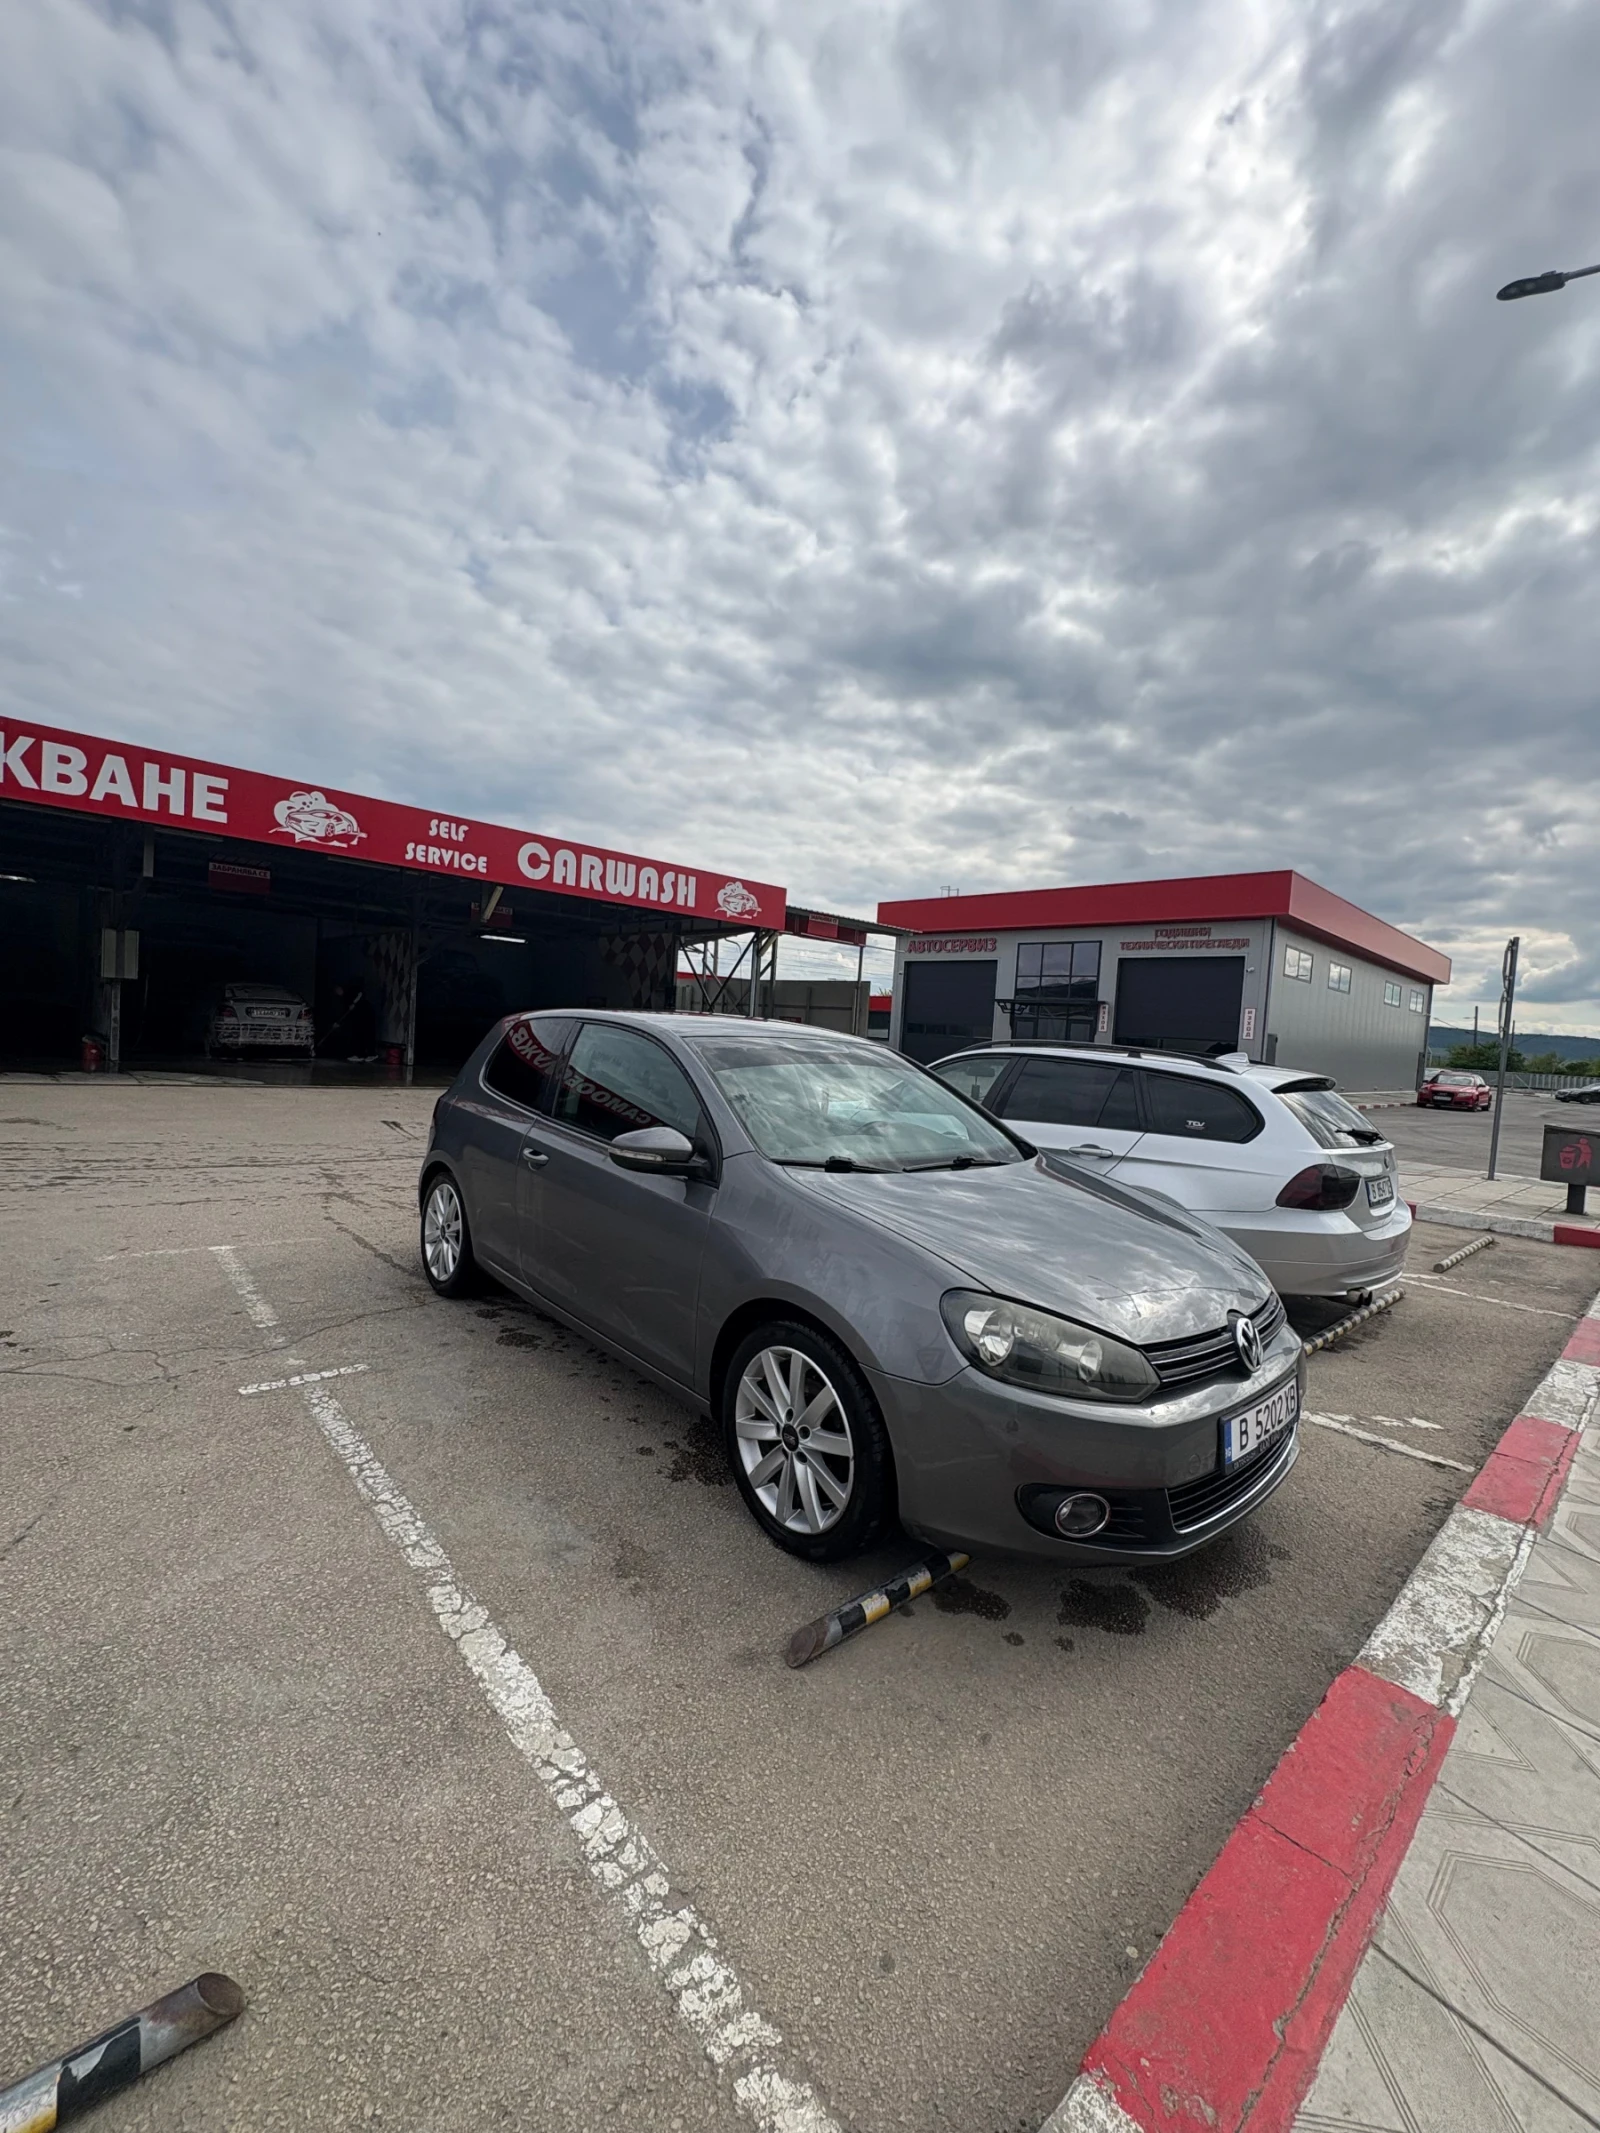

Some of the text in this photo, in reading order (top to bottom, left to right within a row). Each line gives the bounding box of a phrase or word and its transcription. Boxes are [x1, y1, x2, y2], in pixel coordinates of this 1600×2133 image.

[428, 818, 470, 843] SELF
[404, 842, 488, 875] SERVICE
[517, 841, 697, 909] CARWASH
[906, 937, 998, 954] АВТОСЕРВИЗ
[1244, 1009, 1254, 1038] ИЗХОД
[1239, 1417, 1250, 1452] B
[1255, 1394, 1284, 1441] 5202
[1285, 1383, 1297, 1419] XB
